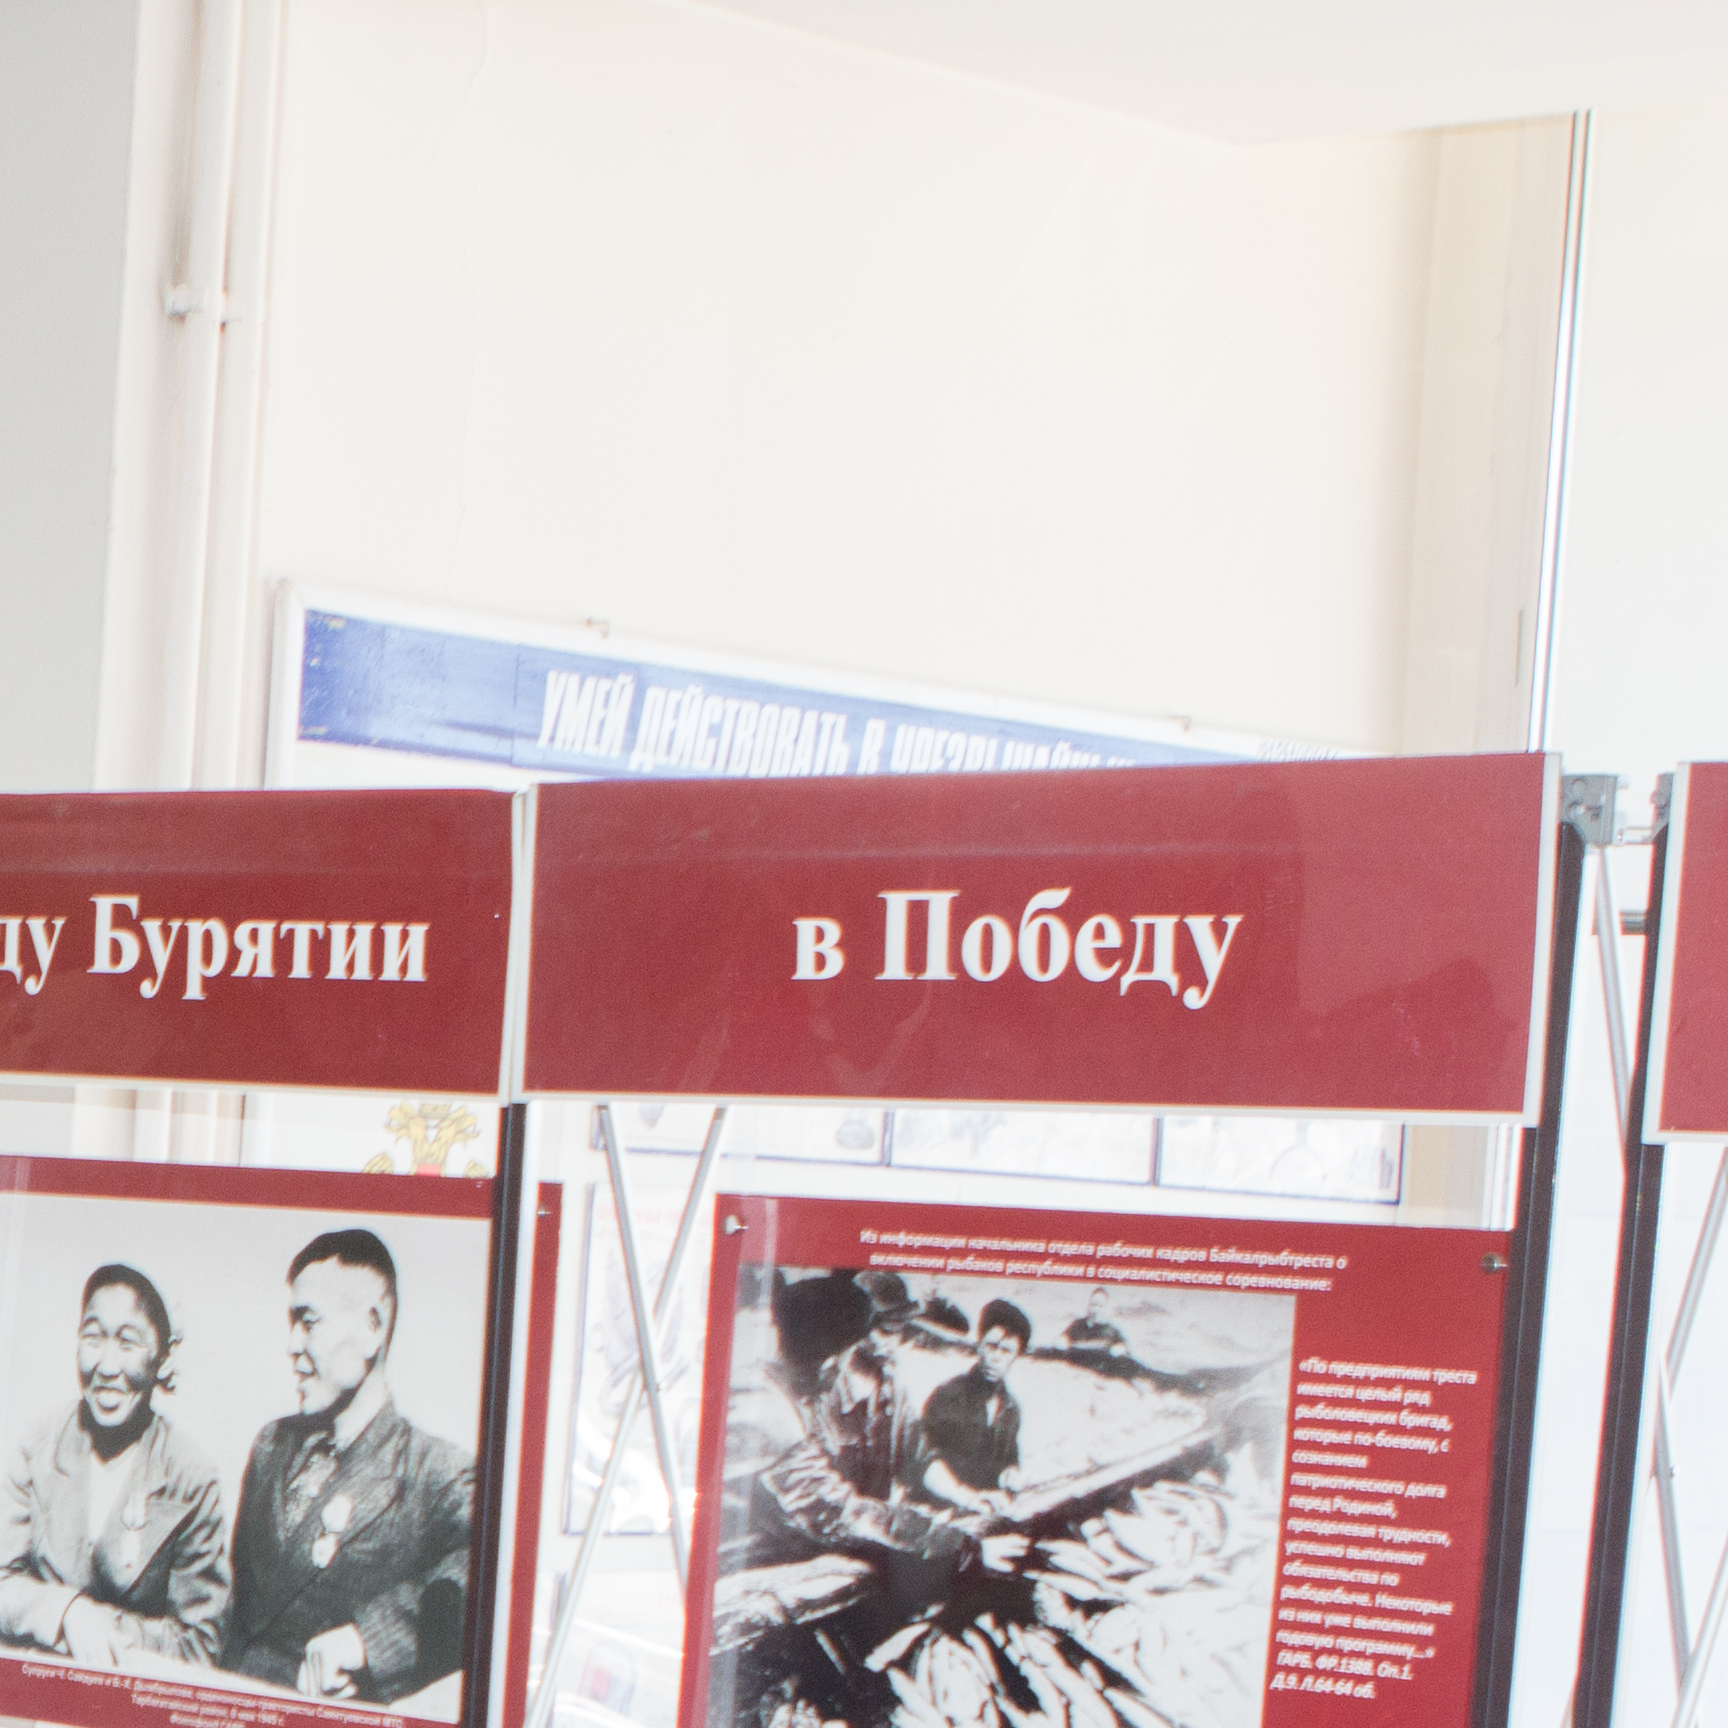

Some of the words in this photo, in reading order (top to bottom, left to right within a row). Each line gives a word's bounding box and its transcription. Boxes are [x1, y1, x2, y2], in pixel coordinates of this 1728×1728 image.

[538, 668, 635, 756] УМЕЙ
[629, 685, 850, 780] ДЕЙСТВОВАТЬ
[858, 719, 885, 775] В
[87, 895, 430, 1000] Бурятии
[791, 914, 845, 981] в
[877, 889, 1244, 1011] Победу
[860, 1230, 879, 1243] Из
[878, 1233, 967, 1248] информации
[966, 1238, 1047, 1252] начальника
[1046, 1242, 1096, 1255] отдела
[1096, 1244, 1154, 1258] рабочих
[1155, 1247, 1208, 1262] кадров
[1208, 1249, 1335, 1267] Байкалрыбтреста
[870, 1254, 946, 1267] включении
[946, 1258, 1005, 1271] рыбаков
[1005, 1261, 1085, 1276] республики
[1096, 1267, 1224, 1284] социалистическое
[1327, 1361, 1432, 1381] предприятиям
[1431, 1369, 1477, 1384] треста
[1296, 1382, 1355, 1398] имеется
[1354, 1386, 1403, 1401] целый
[1402, 1390, 1430, 1405] ряд
[1294, 1404, 1398, 1424] рыболовецких
[1293, 1427, 1353, 1443] которые
[1292, 1451, 1368, 1467] сознанием
[1290, 1473, 1405, 1493] патриотического
[1405, 1483, 1446, 1498] долга
[1288, 1495, 1332, 1511] перед
[1287, 1518, 1378, 1537] преодолевая
[1285, 1540, 1345, 1557] успешно
[1344, 1547, 1425, 1564] выполняют
[1282, 1563, 1380, 1583] обязательства
[1379, 1572, 1399, 1585] по
[1374, 1595, 1452, 1614] Некоторые
[1278, 1608, 1296, 1621] из
[1295, 1610, 1323, 1623] них
[1322, 1613, 1352, 1627] уже
[1352, 1616, 1434, 1635] выполнили
[1276, 1630, 1335, 1648] годовую
